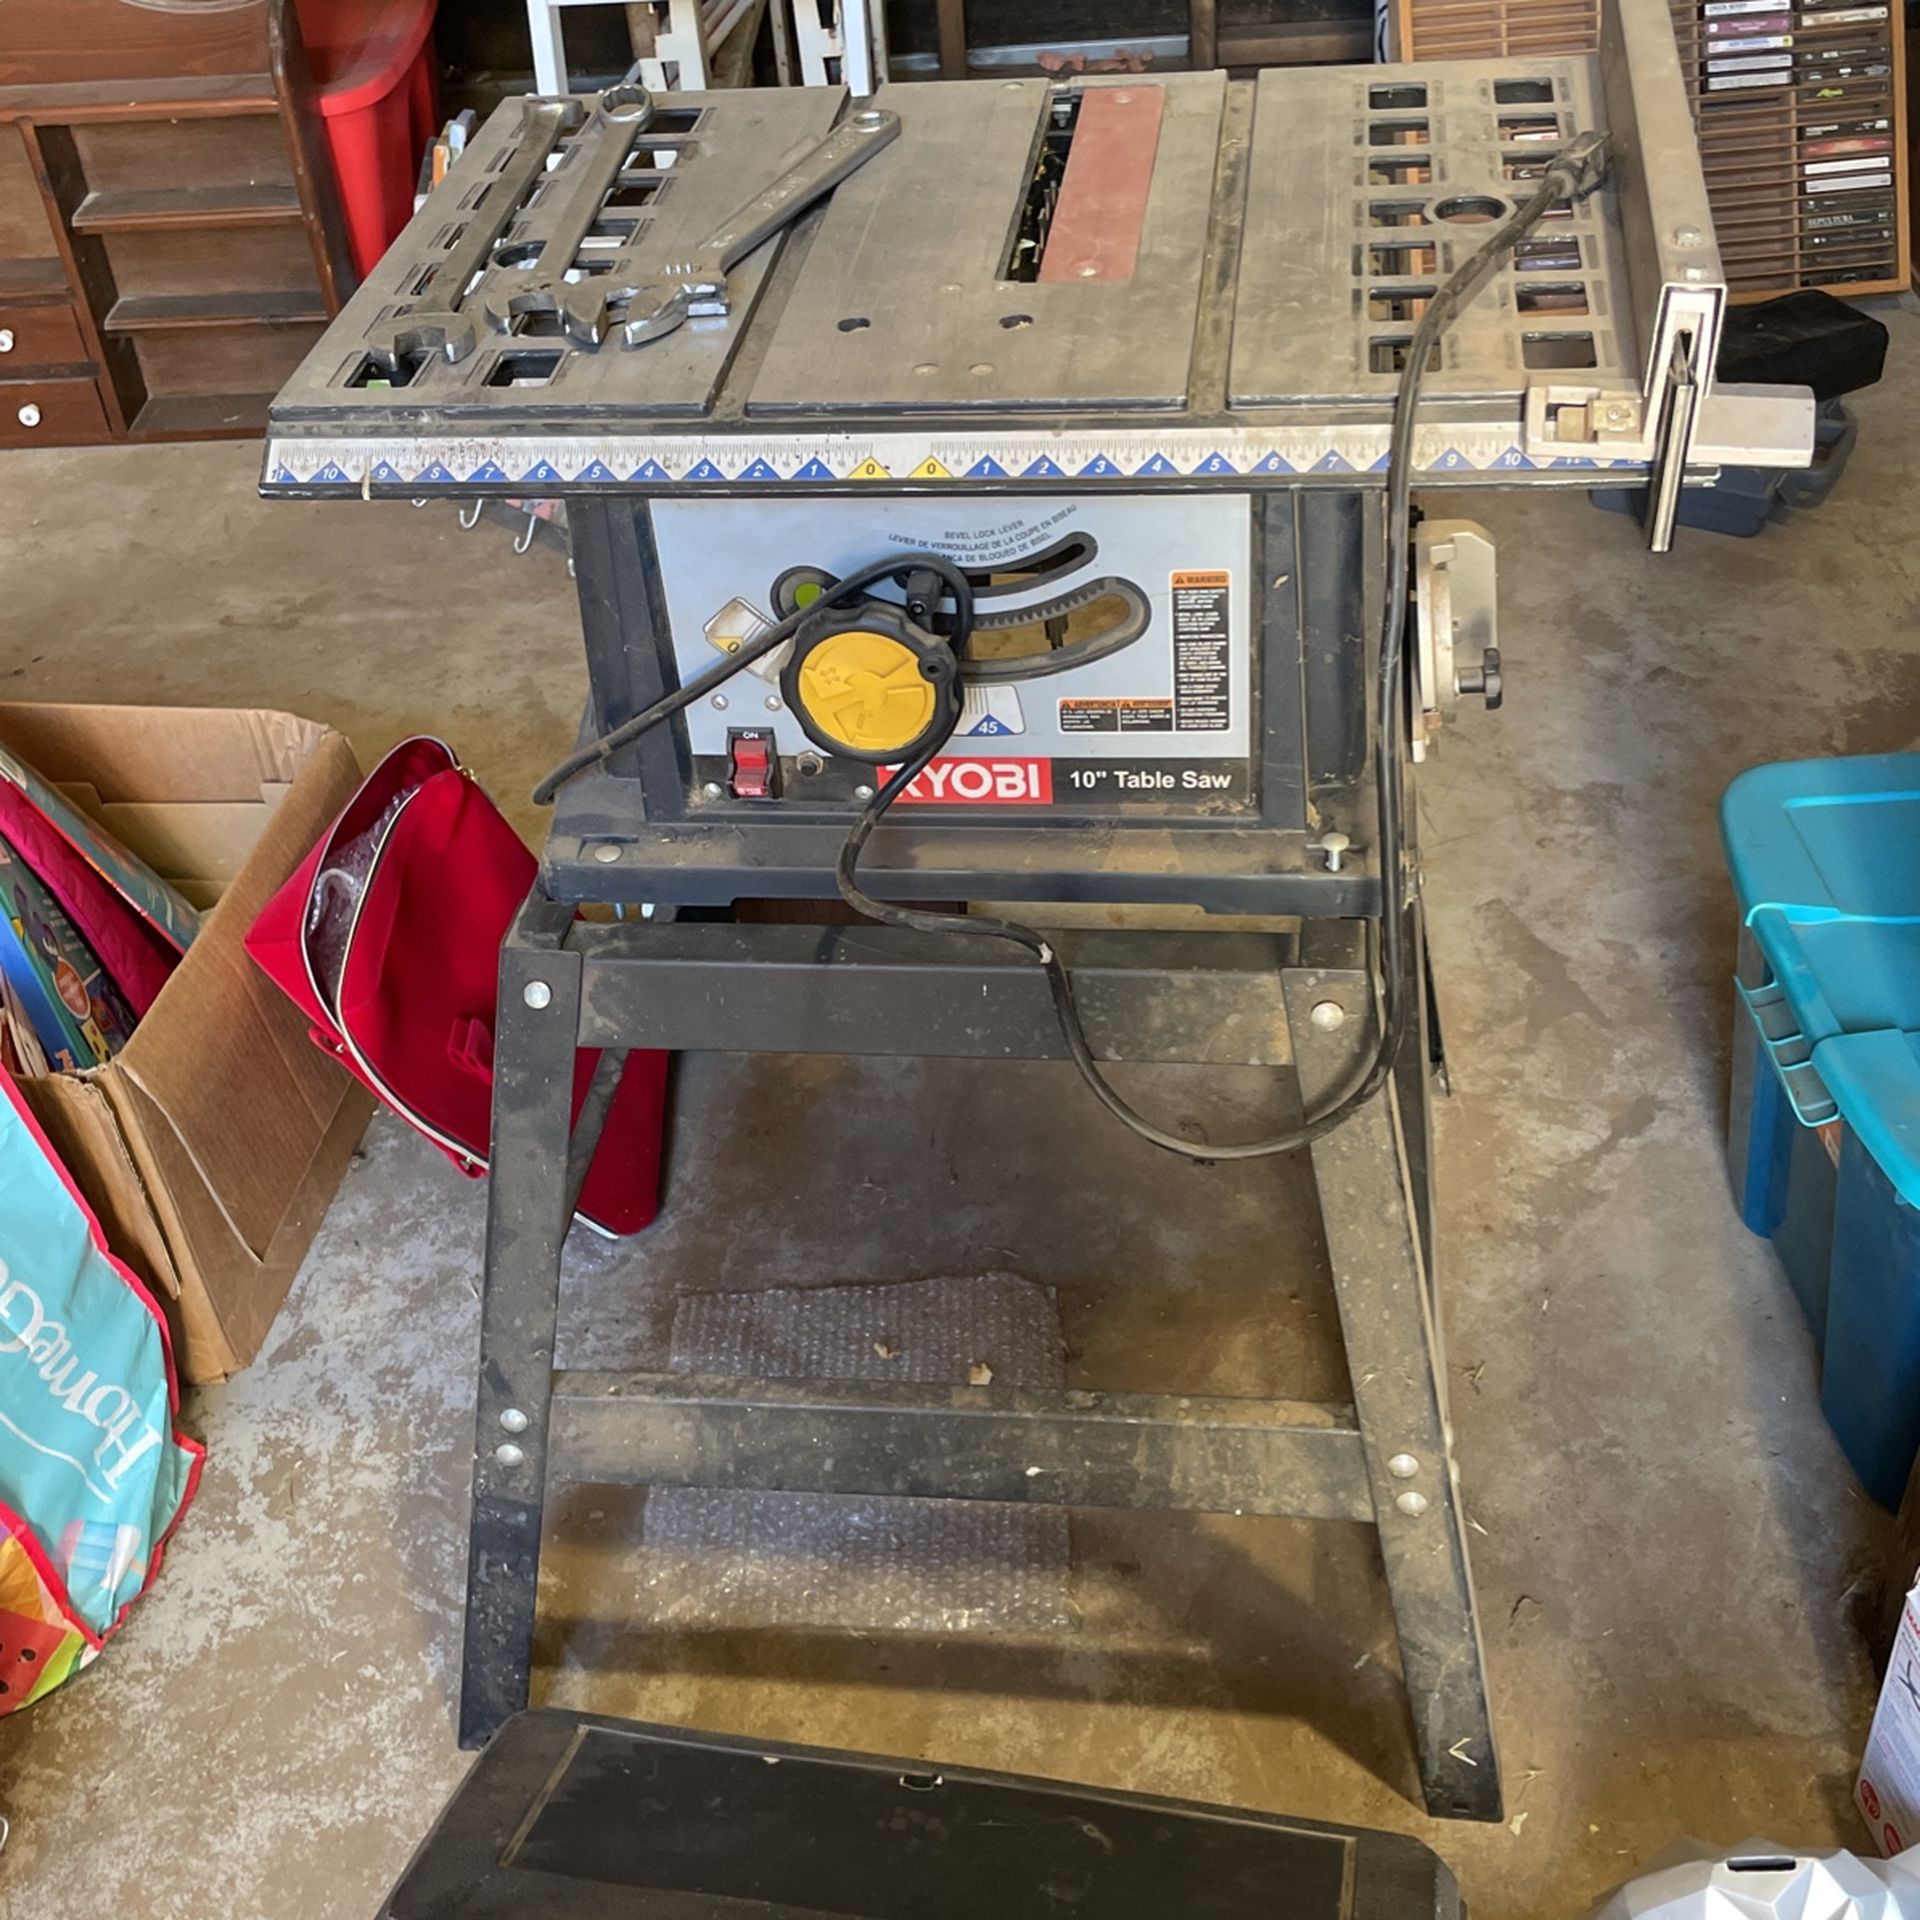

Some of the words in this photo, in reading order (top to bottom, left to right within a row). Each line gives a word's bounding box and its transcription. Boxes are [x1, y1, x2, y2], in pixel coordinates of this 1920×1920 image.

[322, 468, 338, 479] 10
[378, 467, 389, 479] 9
[484, 467, 496, 479] 7
[537, 466, 549, 479] 6
[591, 466, 602, 478] 5
[644, 466, 655, 478] 4
[698, 466, 710, 478] 3
[752, 465, 764, 477] 2
[810, 464, 818, 476] 1
[866, 464, 876, 476] 0
[926, 463, 936, 474] 0
[982, 462, 991, 474] 1
[1038, 462, 1050, 474] 2
[1094, 461, 1106, 474] 3
[1151, 460, 1163, 472] 4
[1209, 458, 1222, 472] 5
[1267, 457, 1280, 470] 6
[1327, 456, 1339, 469] 7
[1446, 452, 1458, 466] 9
[1504, 452, 1521, 466] 10
[888, 532, 916, 547] LEVIER
[917, 538, 929, 549] DE
[991, 539, 1003, 550] DE
[1004, 536, 1015, 547] LA
[1014, 525, 1041, 542] COUPE
[1040, 519, 1052, 531] EN
[1052, 504, 1078, 523] BISEAU
[944, 530, 971, 540] BEVEL
[974, 528, 996, 540] LOCK
[999, 519, 1024, 534] LEVER
[965, 553, 977, 563] DE
[1018, 542, 1031, 552] DE
[1031, 533, 1051, 547] BISEL
[727, 641, 740, 653] 0
[742, 731, 759, 739] ON
[978, 721, 998, 734] 45
[1070, 771, 1107, 789] 10"
[1114, 770, 1175, 789] Table
[1181, 771, 1232, 789] Saw
